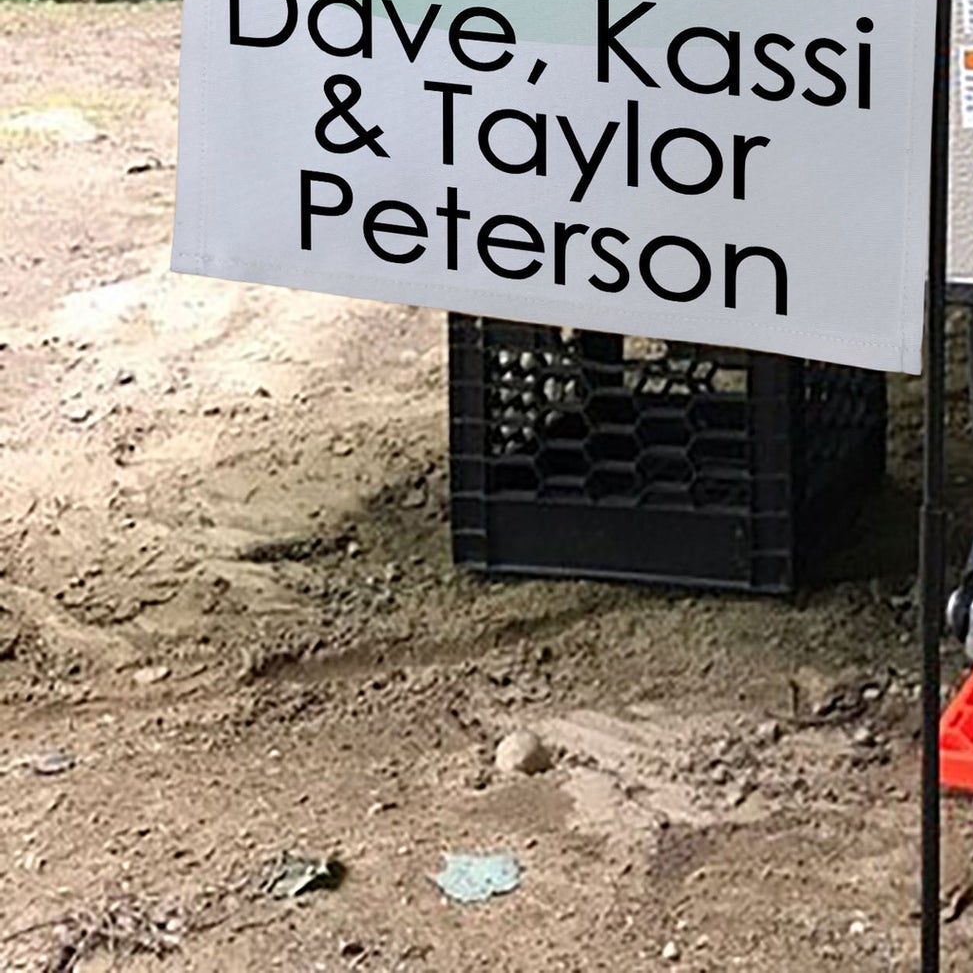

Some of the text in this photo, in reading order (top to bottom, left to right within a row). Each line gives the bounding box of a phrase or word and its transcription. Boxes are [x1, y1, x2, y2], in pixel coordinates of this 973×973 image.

[314, 74, 771, 203] & Taylor
[300, 169, 788, 316] Peterson
